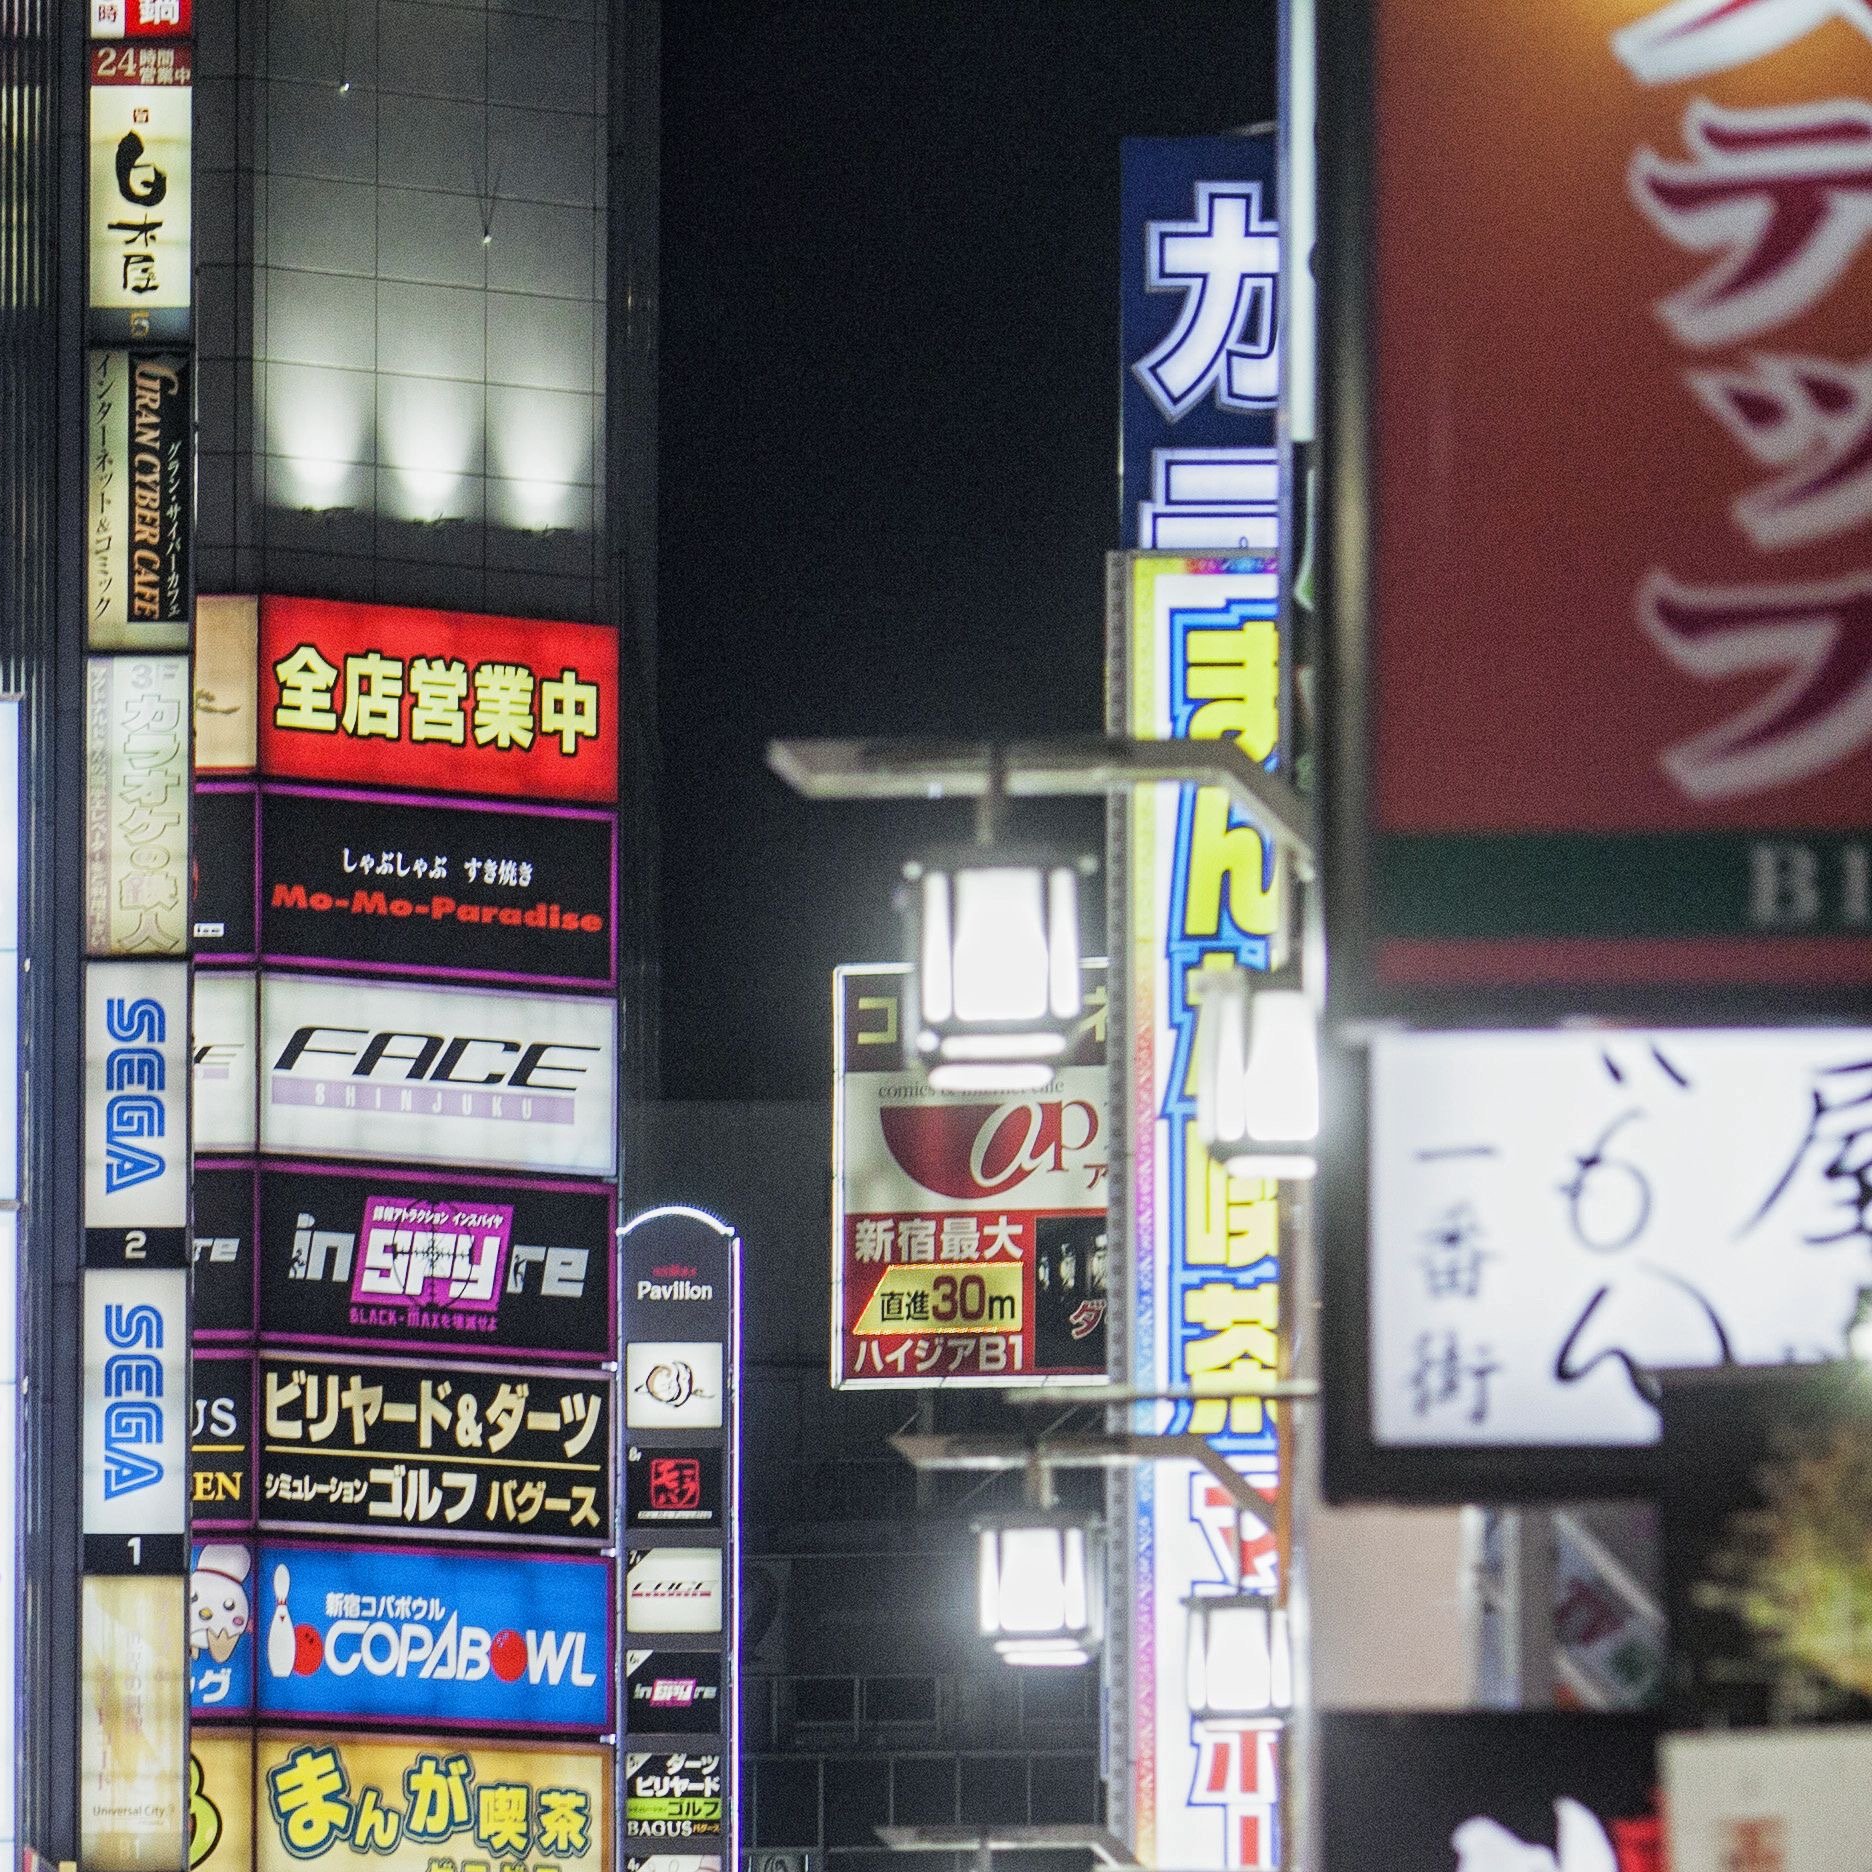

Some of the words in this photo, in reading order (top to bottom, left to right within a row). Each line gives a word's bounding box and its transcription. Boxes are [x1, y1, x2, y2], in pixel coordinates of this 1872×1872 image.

[97, 48, 137, 77] 24
[107, 129, 168, 294] 白木屋
[135, 360, 179, 450] GRAN
[94, 353, 114, 621] インターネット&コミック
[135, 453, 161, 544] CYBER
[134, 550, 160, 620] CAFE
[274, 645, 601, 758] 全店営業中
[341, 848, 448, 880] しゃぶしゃぶ
[463, 856, 535, 888] すき焼き
[271, 883, 604, 934] Mo-Mo-Paradise
[273, 1024, 602, 1094] FACE
[105, 996, 167, 1196] SEGA
[313, 1085, 536, 1122] SHINJUKU
[124, 1231, 147, 1260] 2
[854, 1219, 1025, 1263] 新宿最大
[636, 1280, 714, 1301] Pavilion
[1409, 1143, 1503, 1428] 一番街
[854, 1334, 1025, 1374] ハイジアB1
[103, 1302, 165, 1501] SEGA
[265, 1370, 602, 1458] ビリヤード&ダーツ
[487, 1479, 602, 1529] バグース
[127, 1536, 142, 1566] 1
[325, 1592, 448, 1620] 新宿コパボウル
[635, 1775, 721, 1798] ビリヤード
[665, 1753, 721, 1776] ダーツ
[270, 1745, 591, 1859] まんが喫茶
[667, 1801, 720, 1818] ゴルフ
